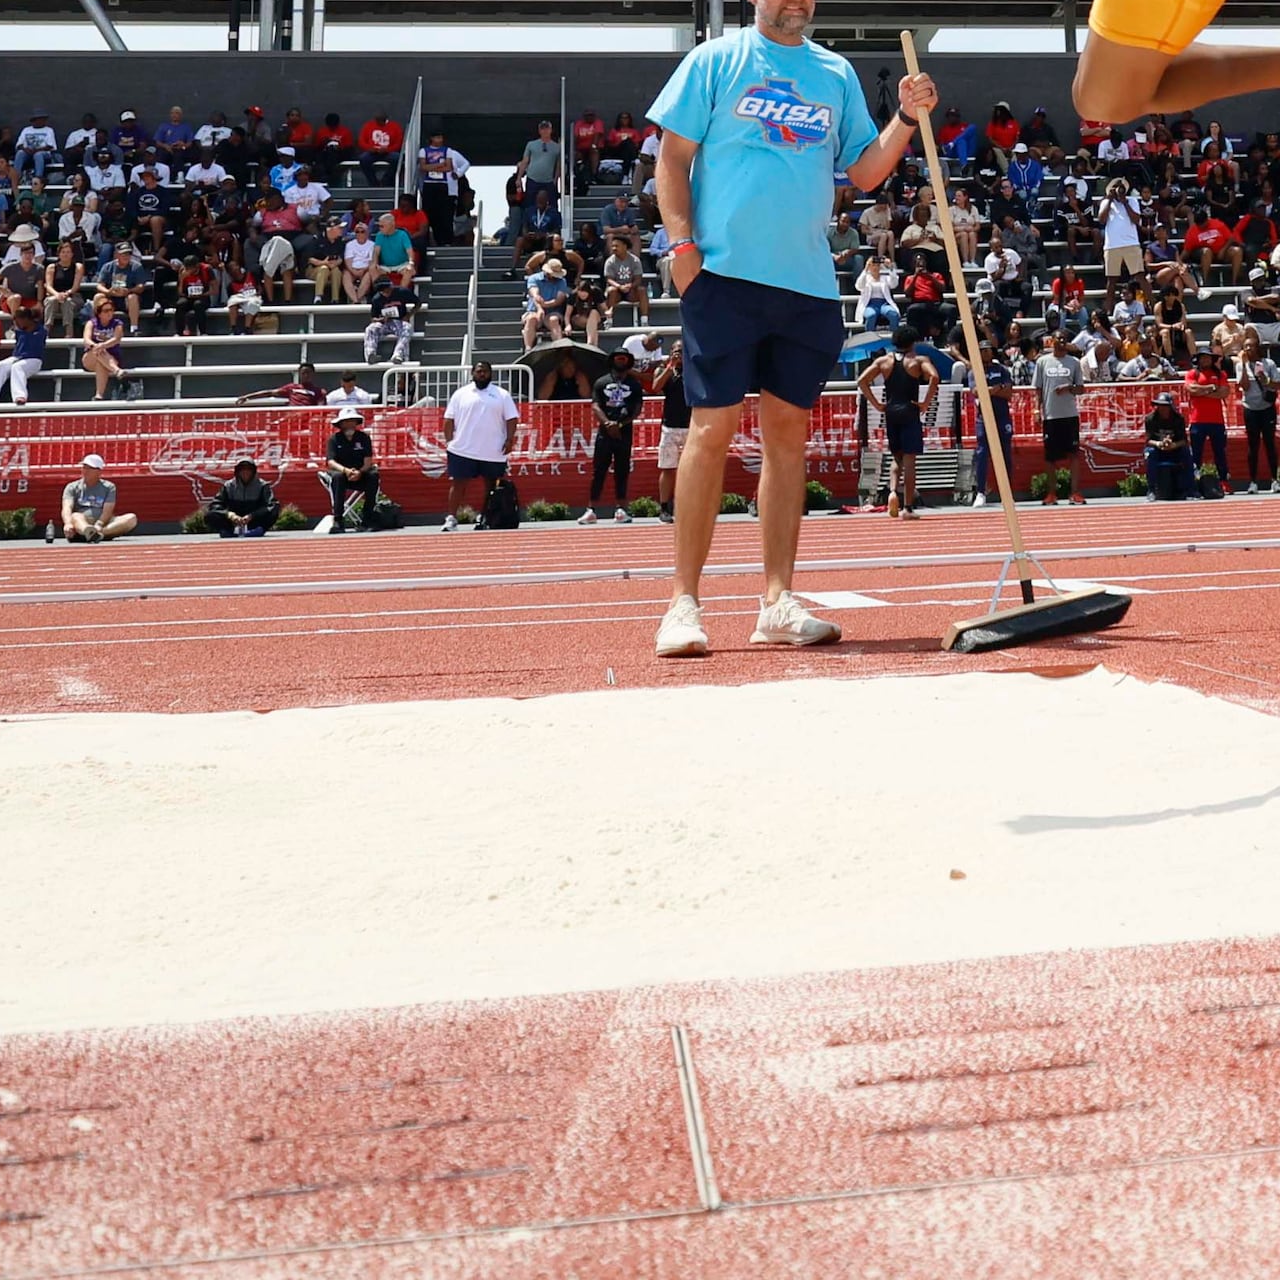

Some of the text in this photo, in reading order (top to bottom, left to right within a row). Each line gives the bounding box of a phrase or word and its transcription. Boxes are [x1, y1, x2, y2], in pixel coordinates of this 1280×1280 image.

[736, 96, 831, 127] GHSA
[512, 427, 599, 460] TLAN
[805, 459, 859, 474] TRAC
